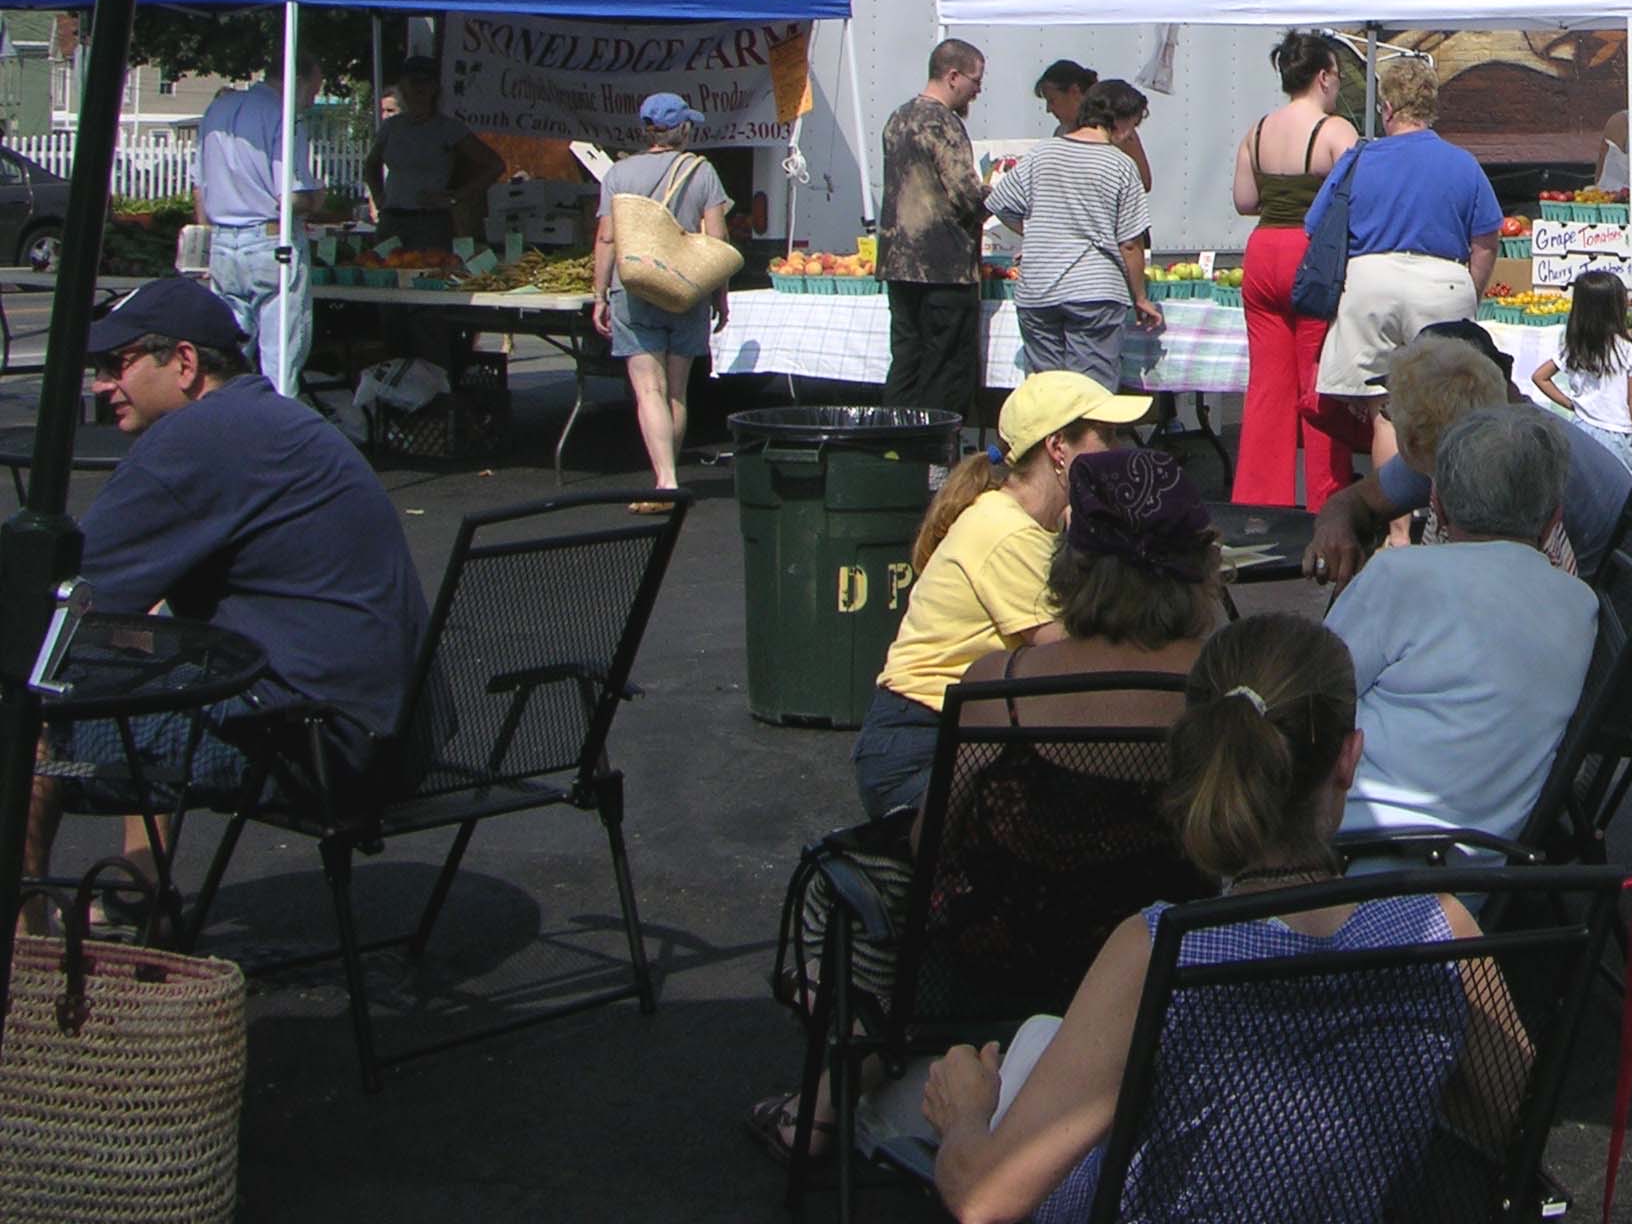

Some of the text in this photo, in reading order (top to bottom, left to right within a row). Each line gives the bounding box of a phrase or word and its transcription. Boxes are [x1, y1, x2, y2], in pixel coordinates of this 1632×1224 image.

[463, 19, 802, 73] STONELEDGE FARM
[454, 108, 510, 127] South
[1535, 227, 1576, 250] Grape
[1578, 226, 1623, 248] Tomatoes
[1538, 259, 1573, 284] Cherry
